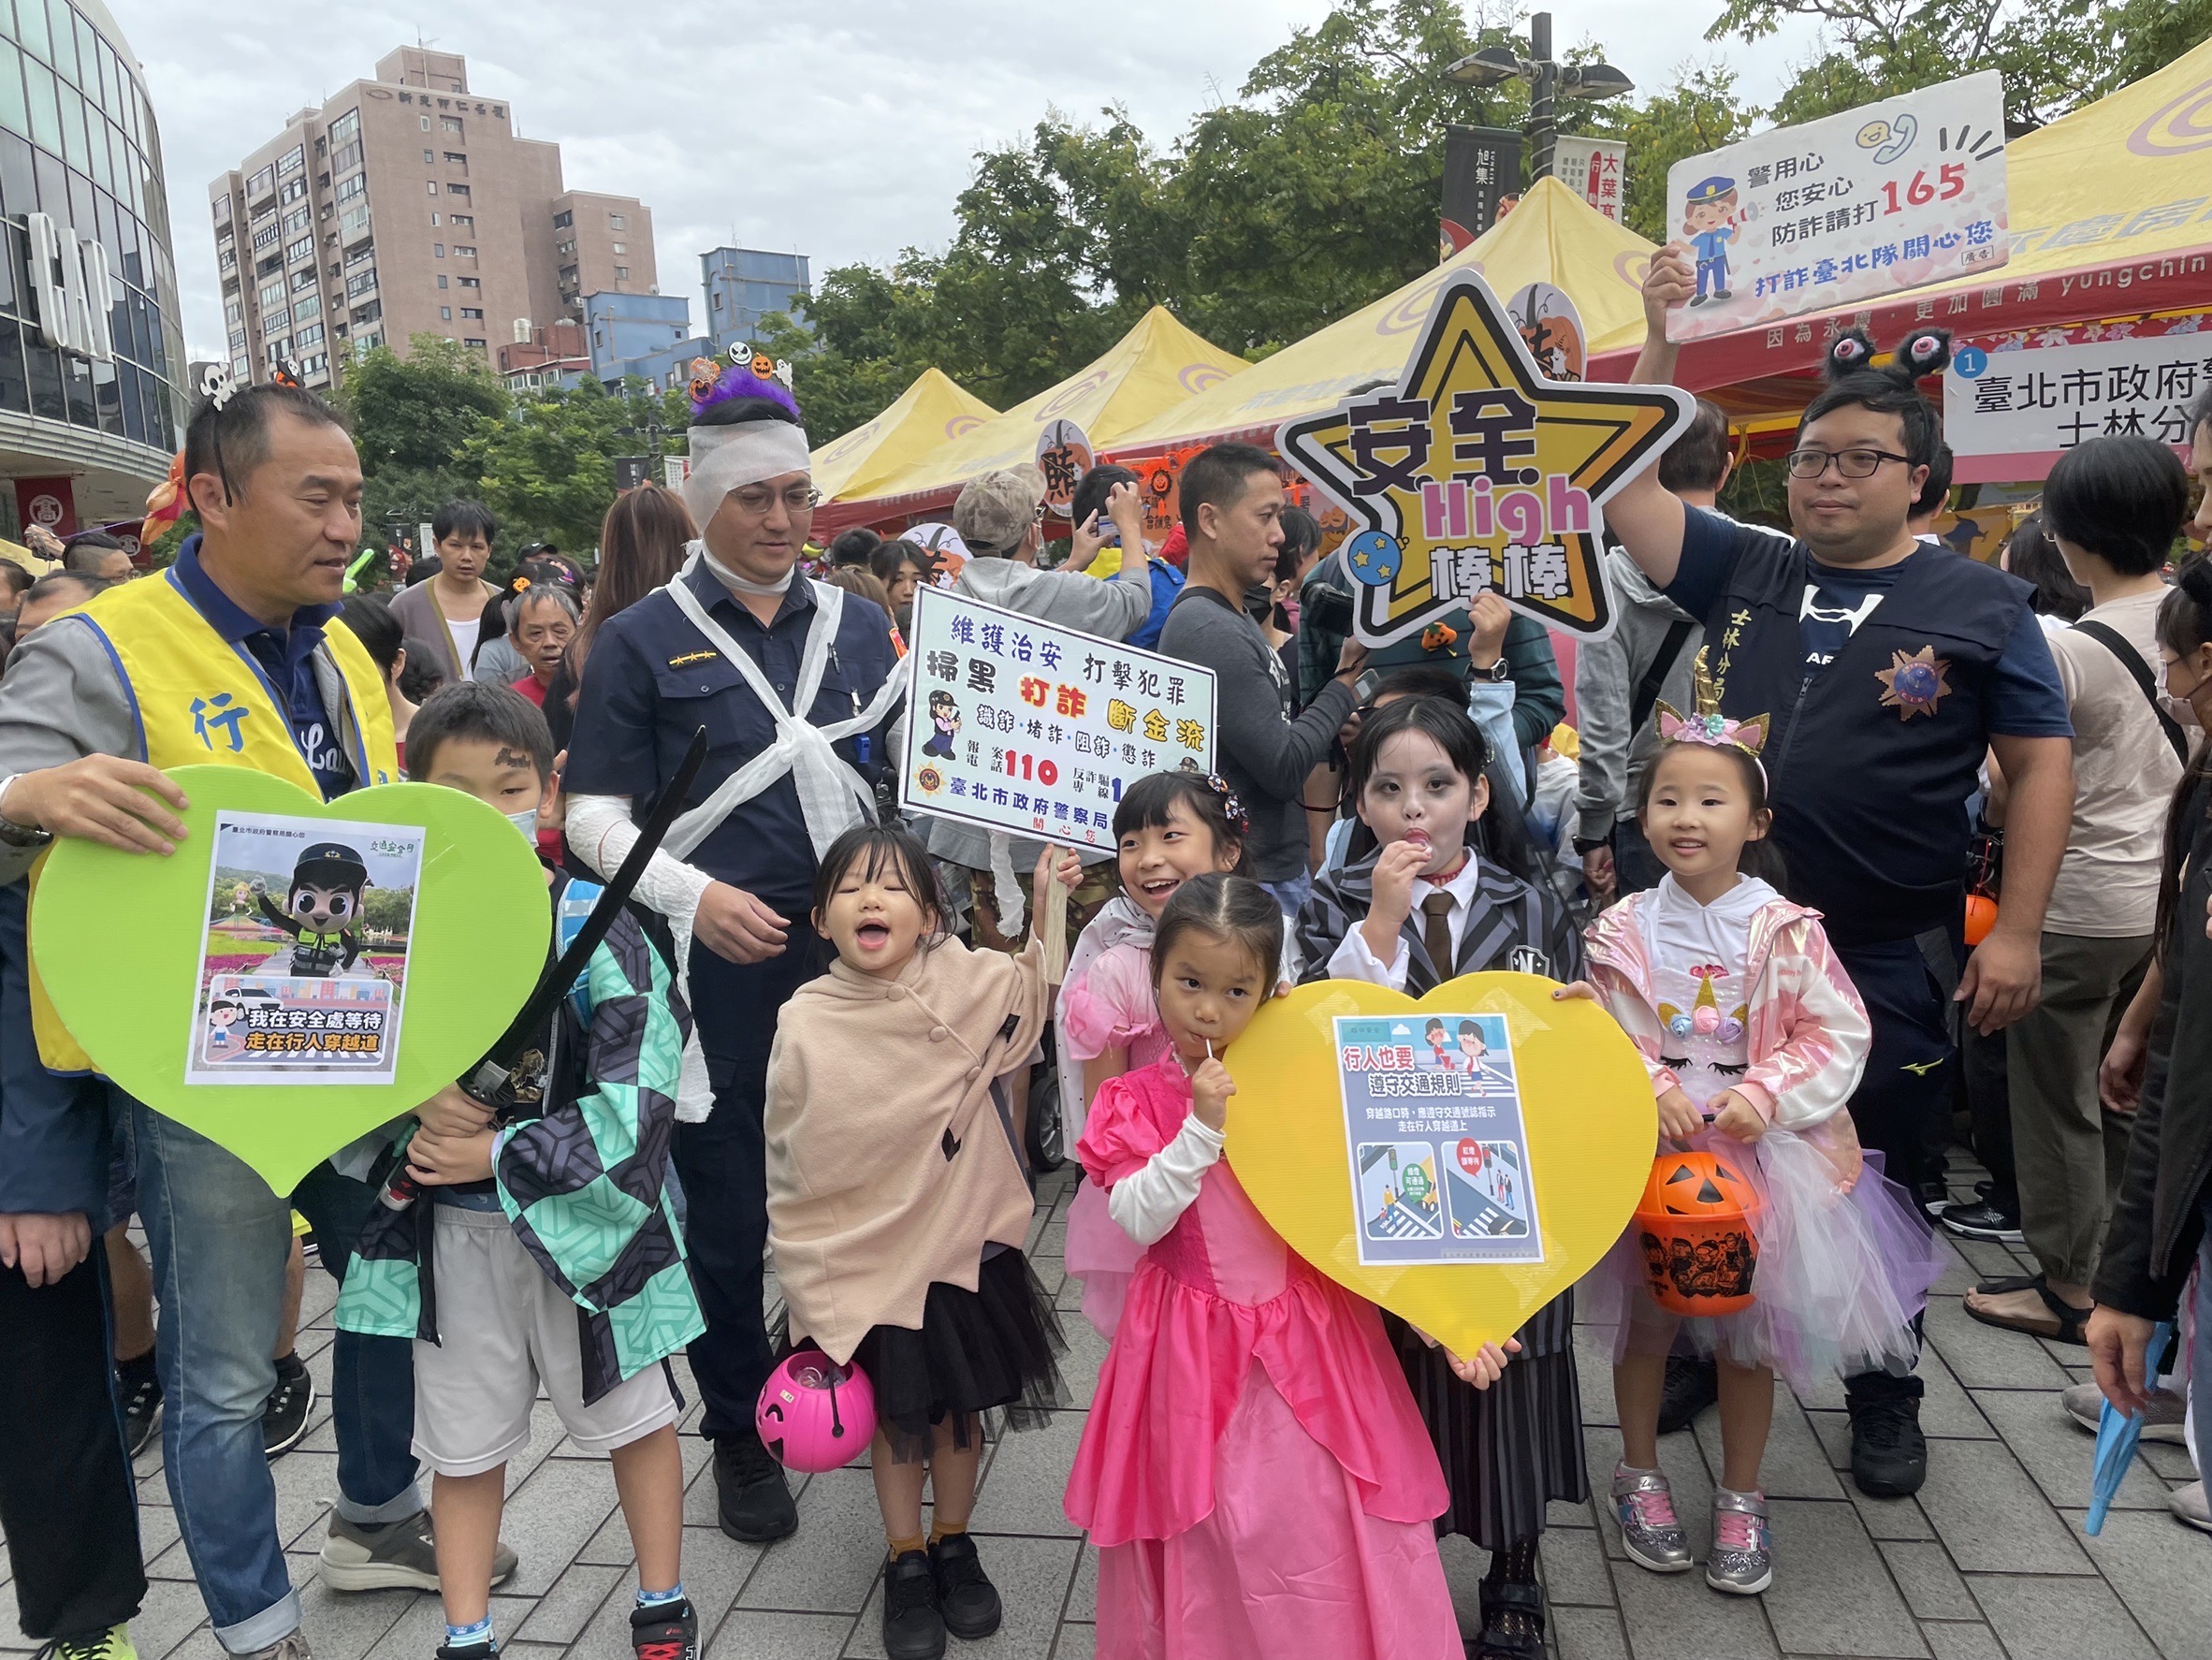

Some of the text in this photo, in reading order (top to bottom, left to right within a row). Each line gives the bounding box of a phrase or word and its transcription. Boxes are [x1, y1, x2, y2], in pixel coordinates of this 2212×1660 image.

[1476, 148, 1490, 185] 旭集
[1747, 152, 1825, 189] 警用心
[1881, 162, 1966, 215] 165
[1775, 176, 1855, 212] 您安心
[1754, 220, 1994, 298] 打詐臺北隊關心您
[1965, 249, 1991, 263] 廣告
[28, 212, 114, 364] GAP
[1964, 353, 1976, 372] 1
[1974, 357, 2212, 414] 臺北市政府
[1349, 388, 1540, 496] 安全
[1421, 474, 1591, 546] High
[1430, 544, 1571, 601] 棒棒
[950, 614, 1186, 706] 維護治安 打擊犯罪
[1713, 608, 1753, 702] 士林分局
[189, 692, 250, 753] 行
[926, 650, 1205, 752] 掃黑 打詐 斷金流
[1005, 750, 1058, 786] 110
[950, 776, 1109, 830] 臺北市政府警察局
[245, 1031, 380, 1053] 走在行人穿越道
[248, 1009, 382, 1030] 我在安全處等待
[1343, 1046, 1415, 1070] 行人也要
[1368, 1073, 1462, 1097] 遵守交通規則
